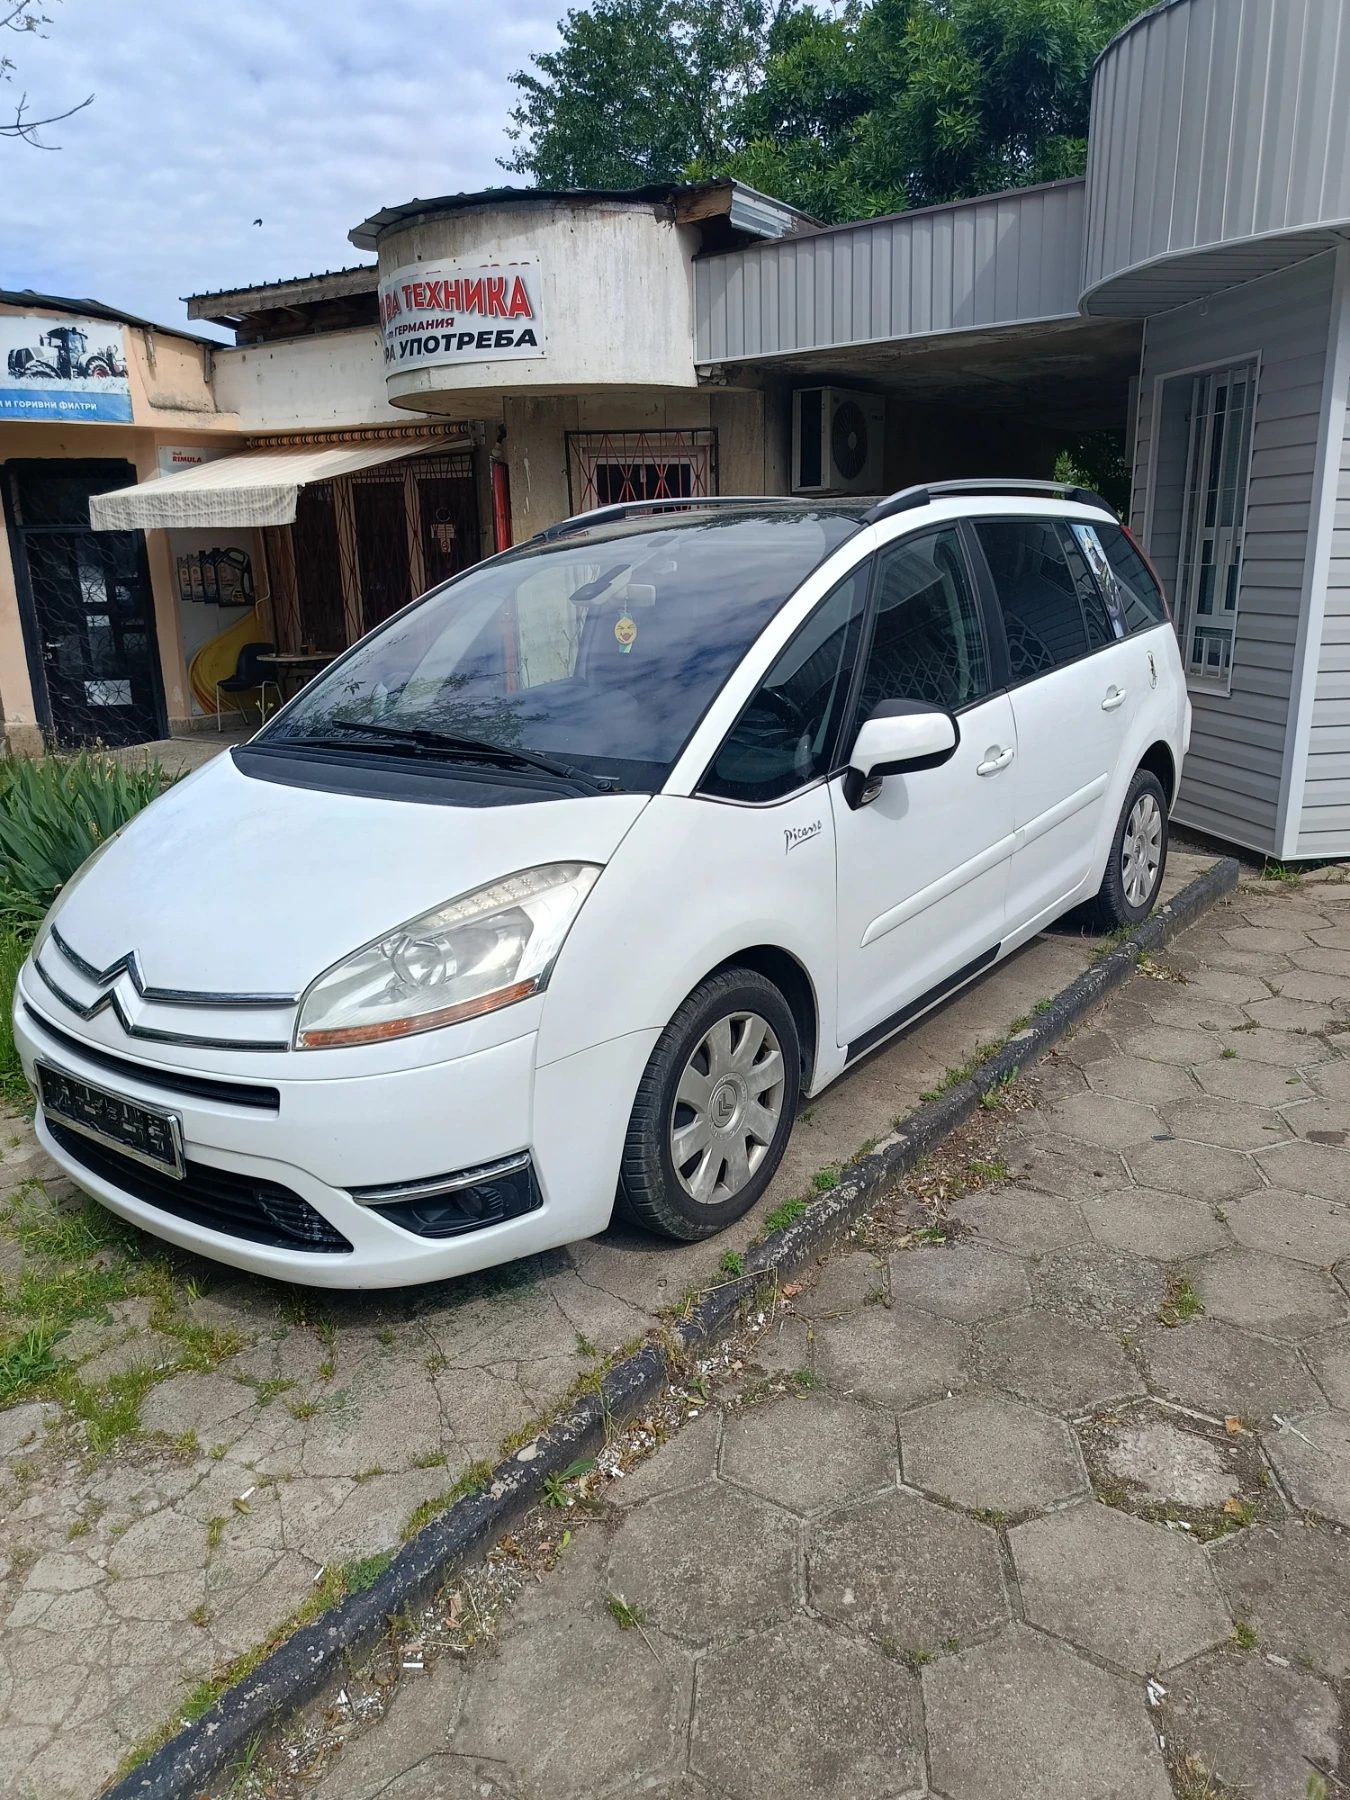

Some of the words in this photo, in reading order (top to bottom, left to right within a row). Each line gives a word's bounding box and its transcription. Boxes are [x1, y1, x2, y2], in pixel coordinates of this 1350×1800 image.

[401, 276, 533, 319] ТЕХНИКА
[394, 317, 455, 337] ГЕРМАНИЯ
[384, 344, 397, 365] РА
[399, 329, 538, 359] УПОТРЕБА
[4, 400, 12, 408] И
[13, 400, 57, 409] ГОРИВНИ
[59, 401, 97, 410] ФИЛТРИ
